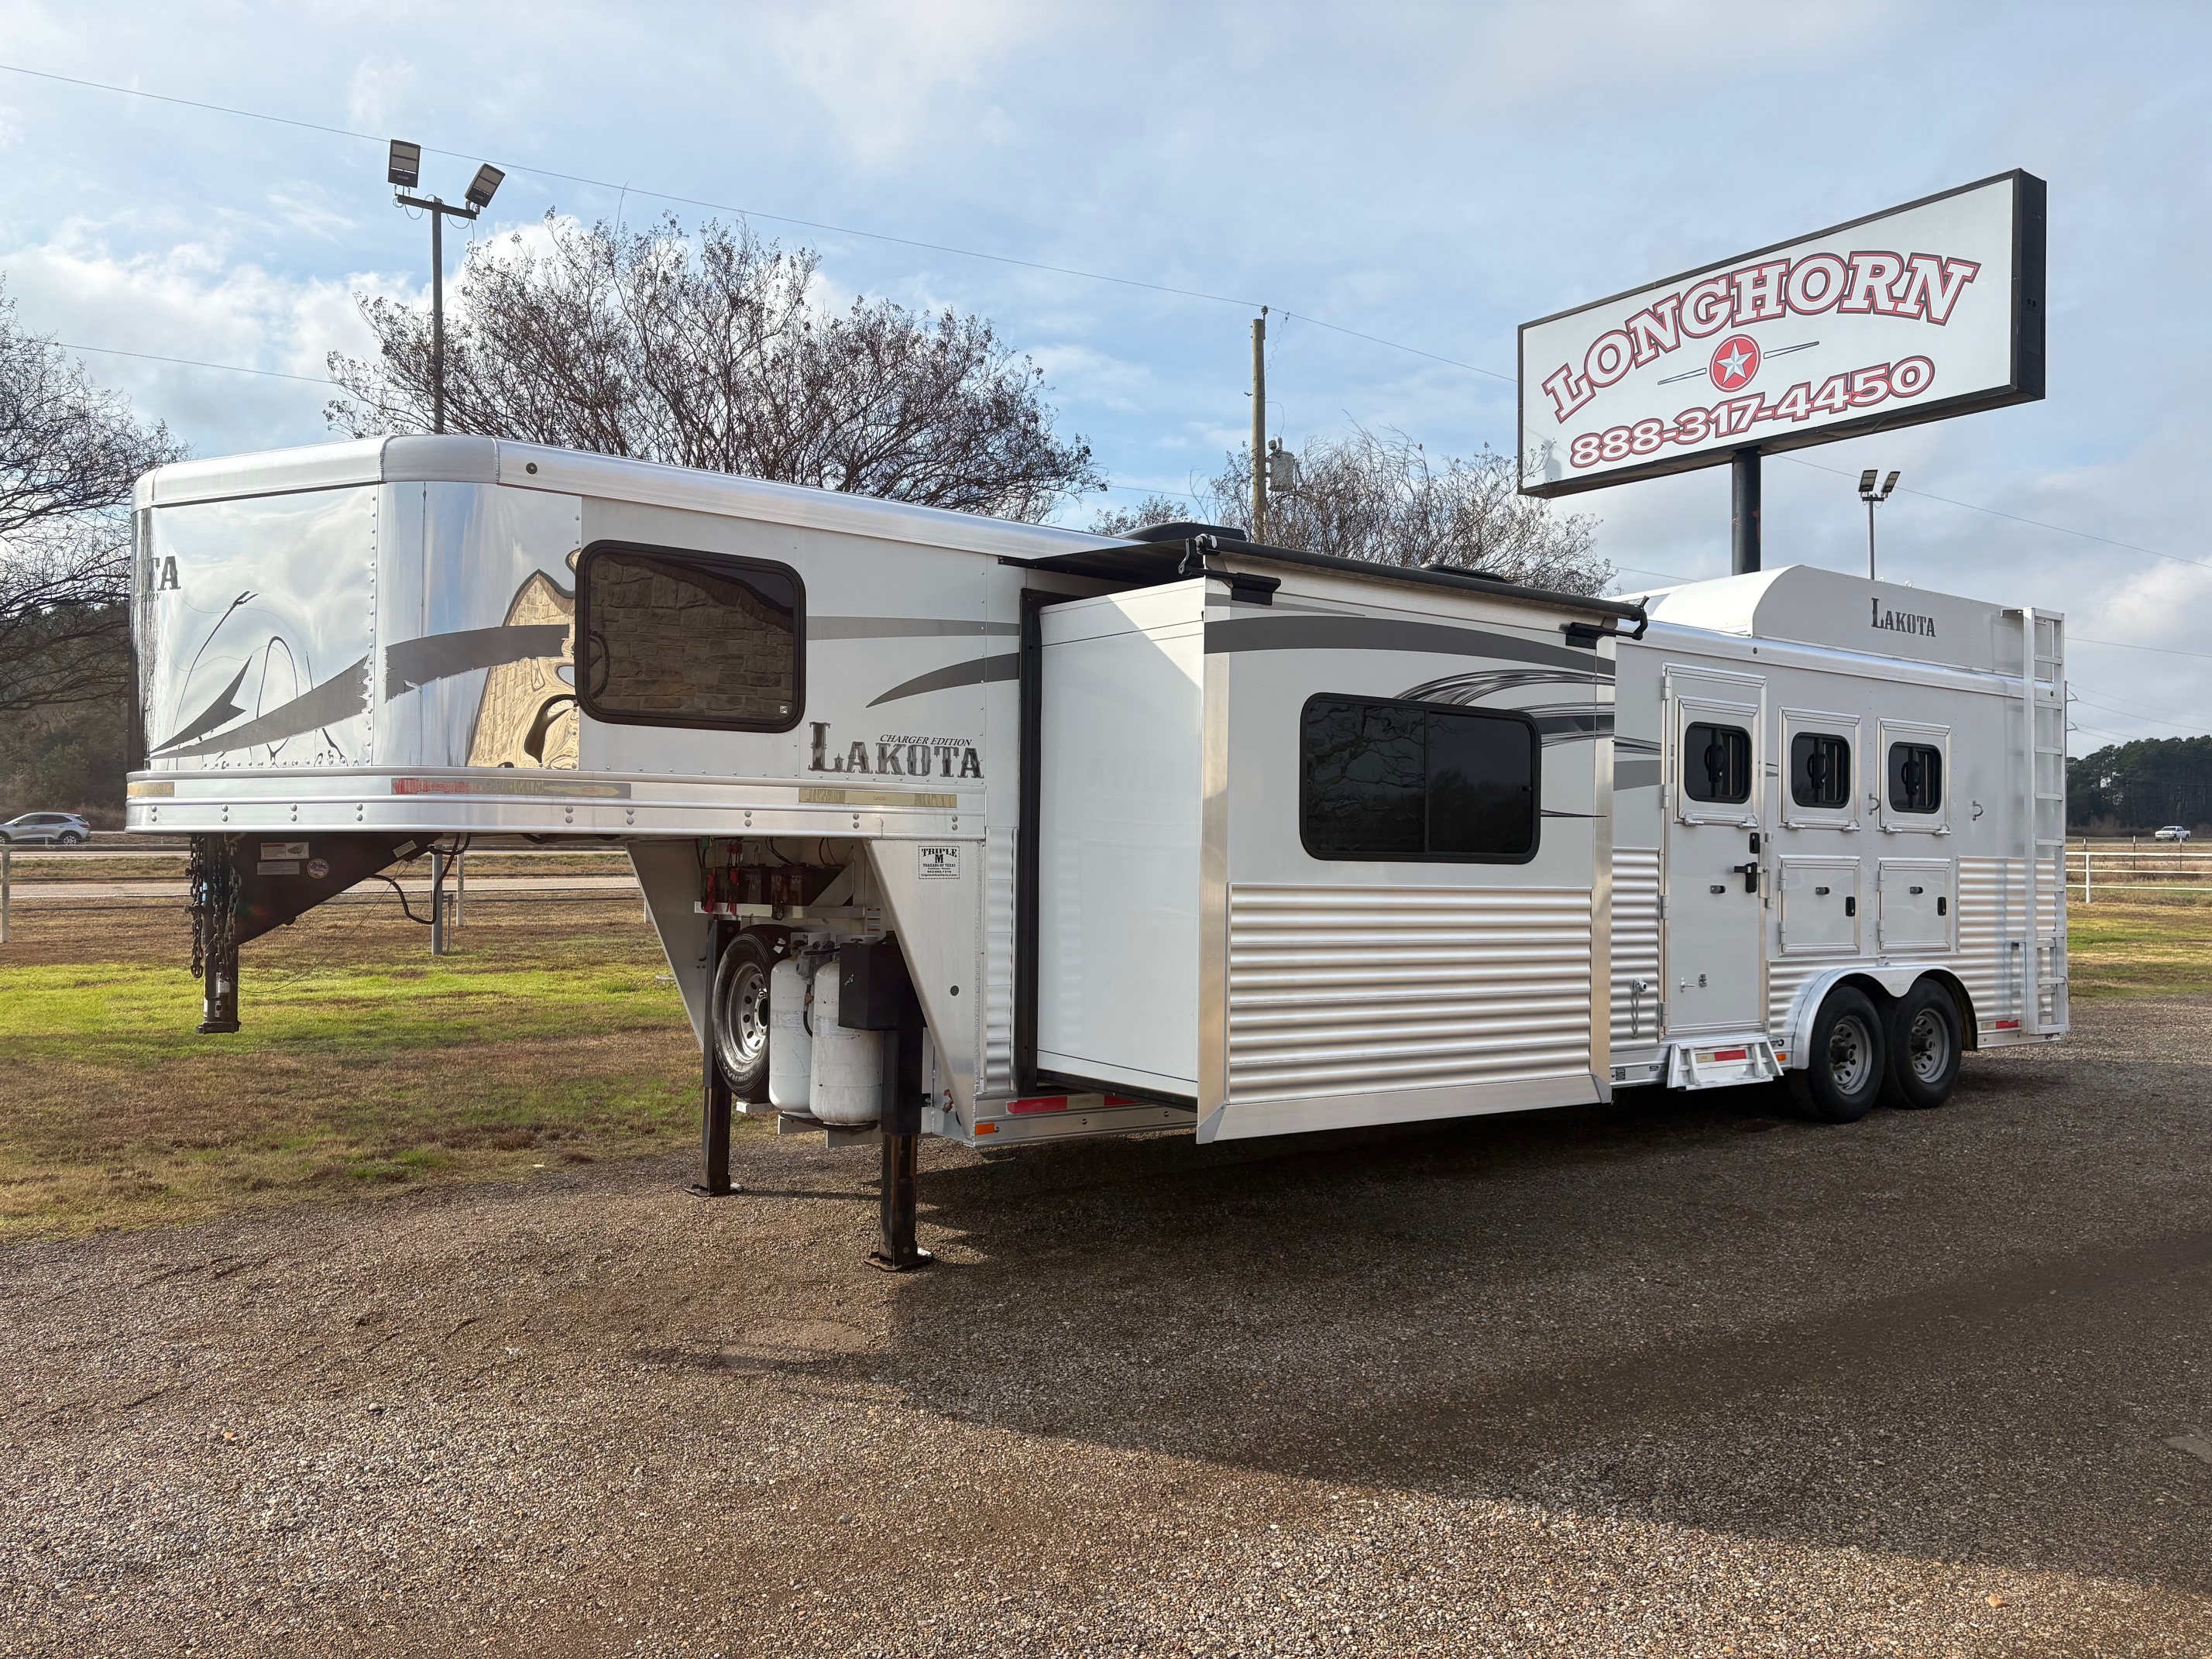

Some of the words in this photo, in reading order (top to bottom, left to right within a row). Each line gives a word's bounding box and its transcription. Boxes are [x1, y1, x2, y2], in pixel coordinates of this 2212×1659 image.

[1542, 250, 1982, 423] LONGHORN
[1570, 355, 1936, 469] 888-317-4450
[1870, 597, 1936, 637] LAKOTA
[807, 721, 985, 779] LAKOTA
[880, 734, 929, 745] CHARGER
[931, 737, 972, 747] EDITION
[921, 848, 957, 858] TRIPLE
[934, 854, 944, 864] M
